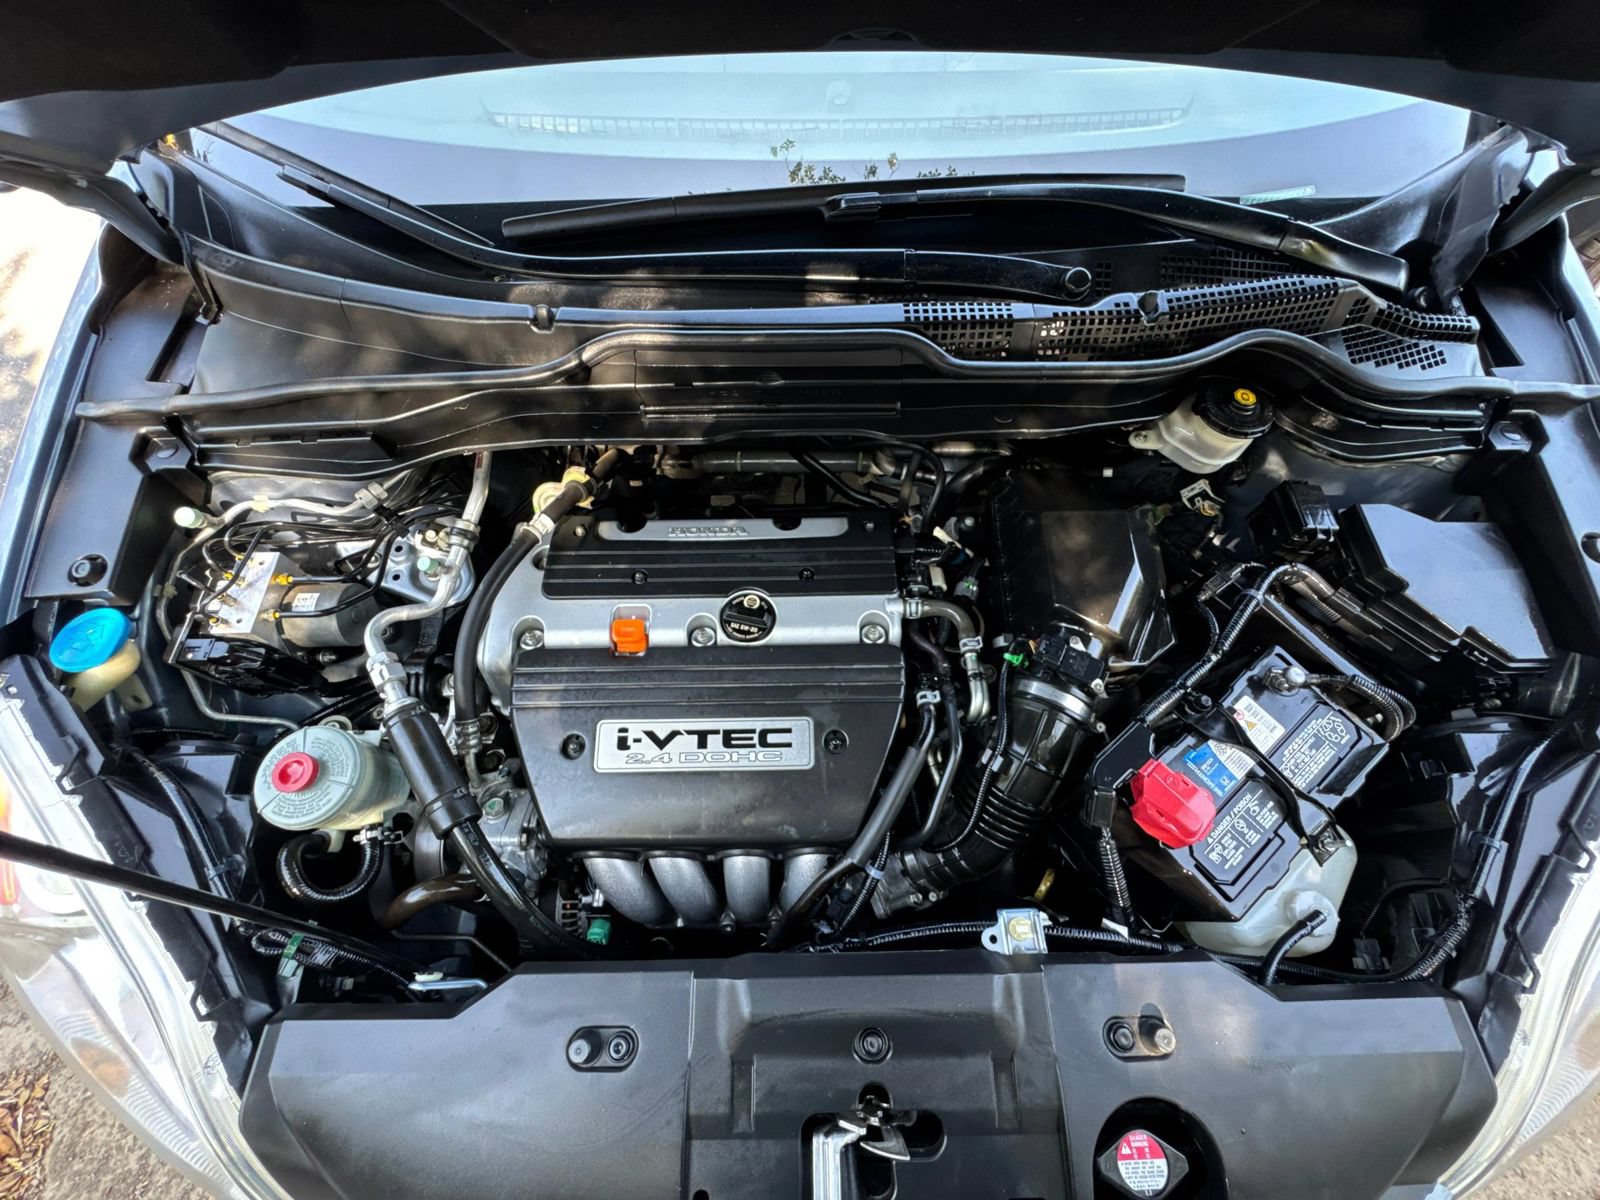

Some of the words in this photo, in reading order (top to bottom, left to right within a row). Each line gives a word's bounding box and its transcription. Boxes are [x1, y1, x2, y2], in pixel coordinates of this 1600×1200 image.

[667, 527, 750, 537] HONDA
[616, 727, 793, 751] i-VTEC
[625, 751, 672, 764] 2.4
[678, 750, 783, 764] DOHC
[1211, 815, 1231, 839] DANGER
[1233, 793, 1252, 815] POISON
